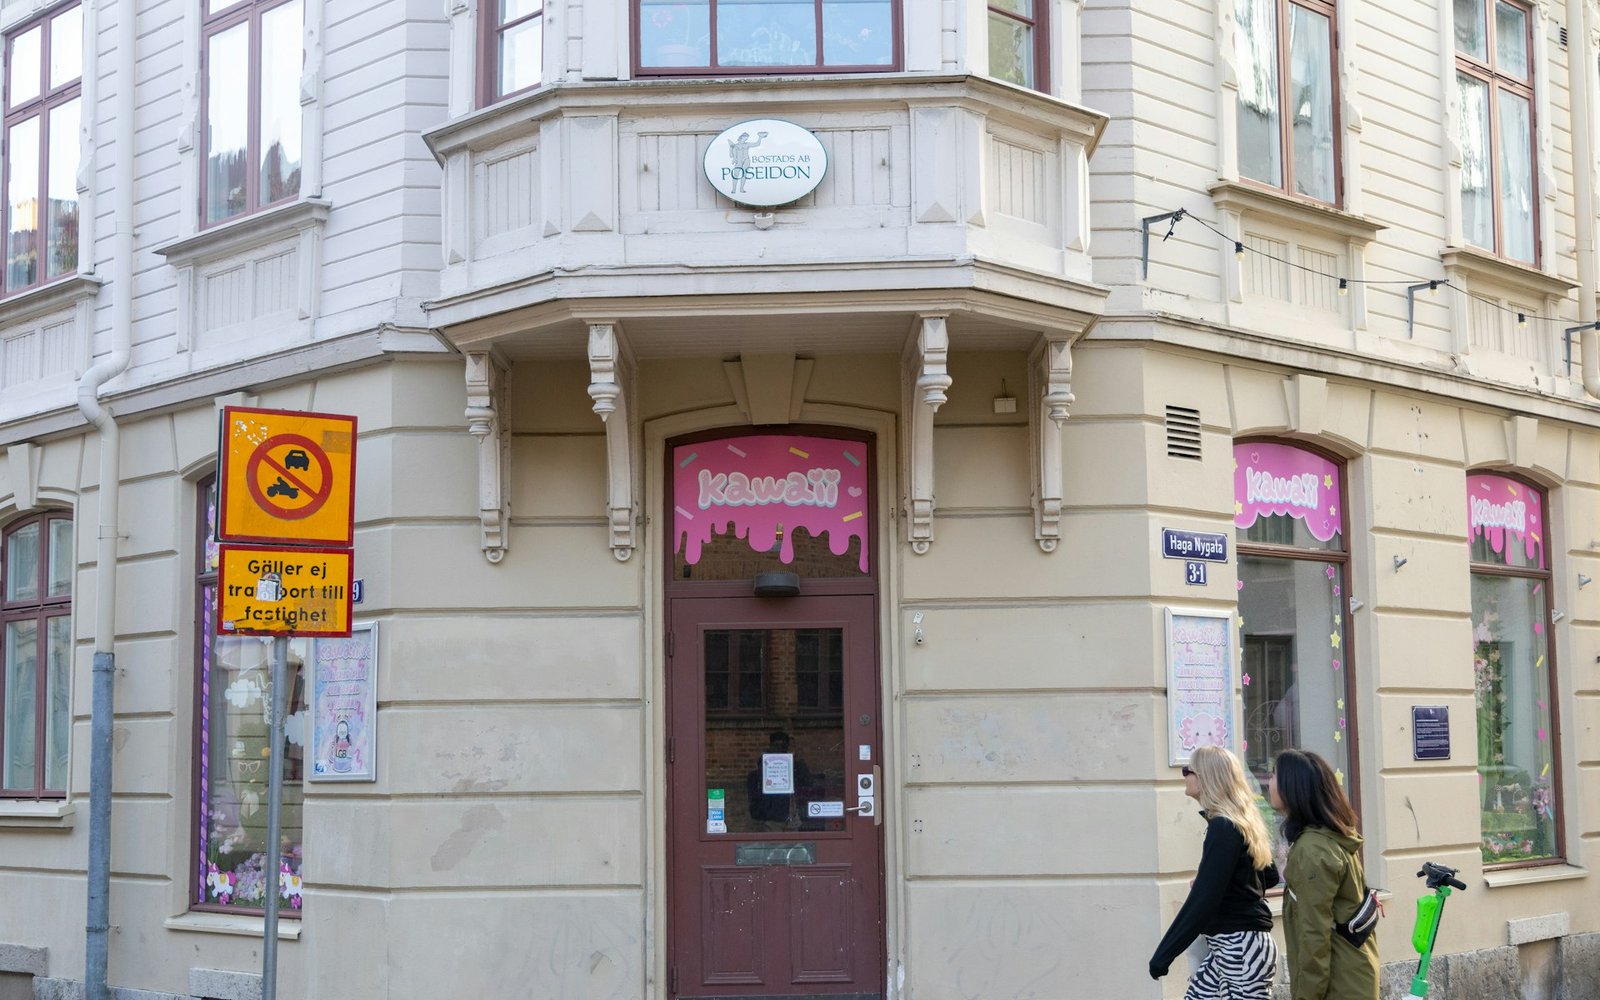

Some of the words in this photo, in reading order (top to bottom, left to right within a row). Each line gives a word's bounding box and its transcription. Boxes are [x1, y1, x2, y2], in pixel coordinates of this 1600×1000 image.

[751, 155, 796, 163] BOSTADS
[797, 154, 811, 163] AB
[721, 165, 811, 180] POSEIDON
[698, 467, 841, 510] kawaii
[1245, 466, 1319, 510] kawaii
[1470, 494, 1526, 533] kawaii
[1169, 534, 1193, 554] Haga
[1194, 536, 1223, 557] Nygata
[247, 559, 304, 576] Gäller
[310, 562, 327, 580] ej
[228, 584, 315, 600] traport
[321, 585, 344, 600] till
